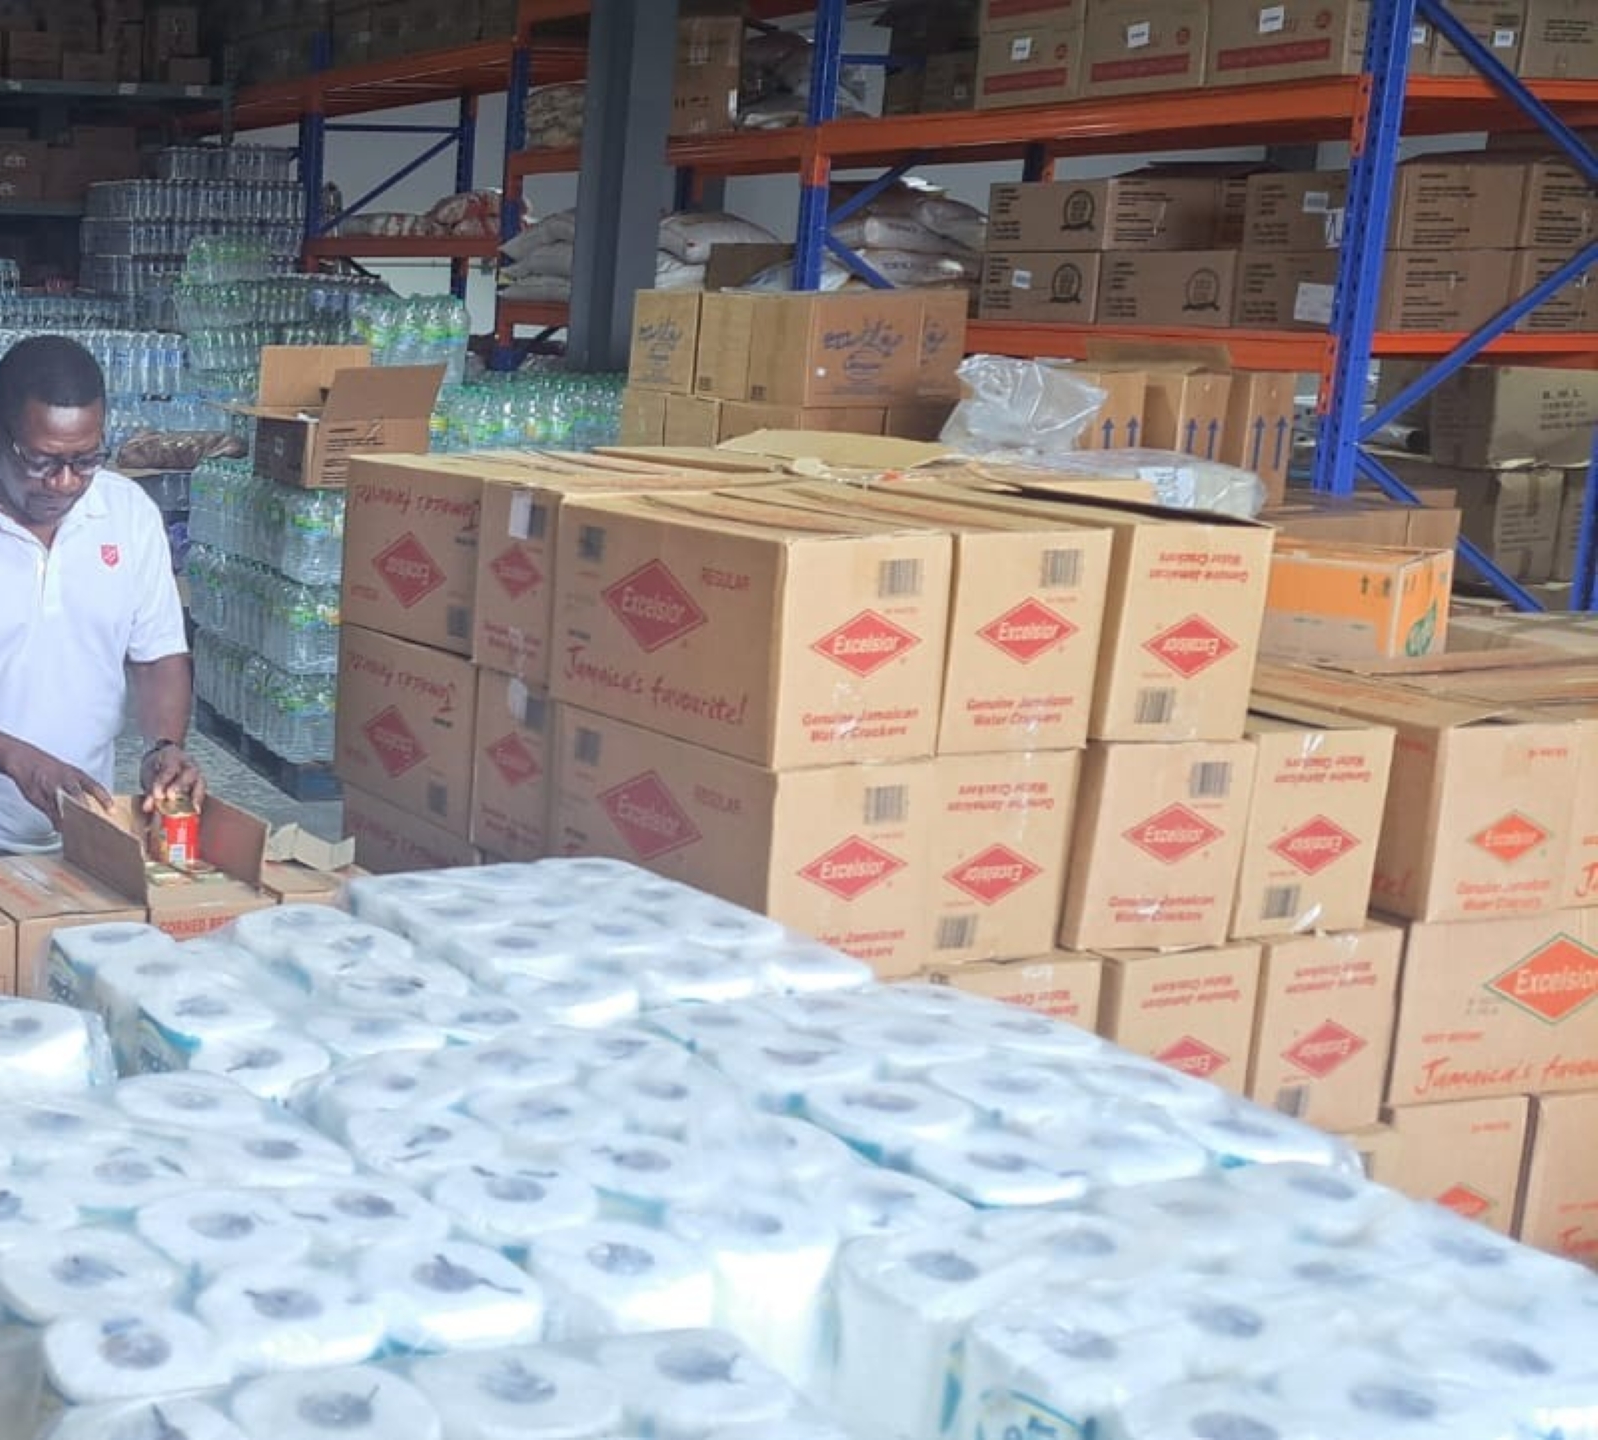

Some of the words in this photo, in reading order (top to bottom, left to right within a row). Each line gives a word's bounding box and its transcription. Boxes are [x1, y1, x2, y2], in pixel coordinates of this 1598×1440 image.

[701, 566, 751, 591] REGULAR
[622, 586, 686, 624] Excelsior
[997, 621, 1061, 641] Excelsior
[832, 633, 901, 655] Excelsior
[564, 644, 642, 694] Jamaica's
[651, 675, 748, 725] favourite!
[1144, 825, 1206, 843] Excelsior
[819, 857, 886, 880] Excelsior
